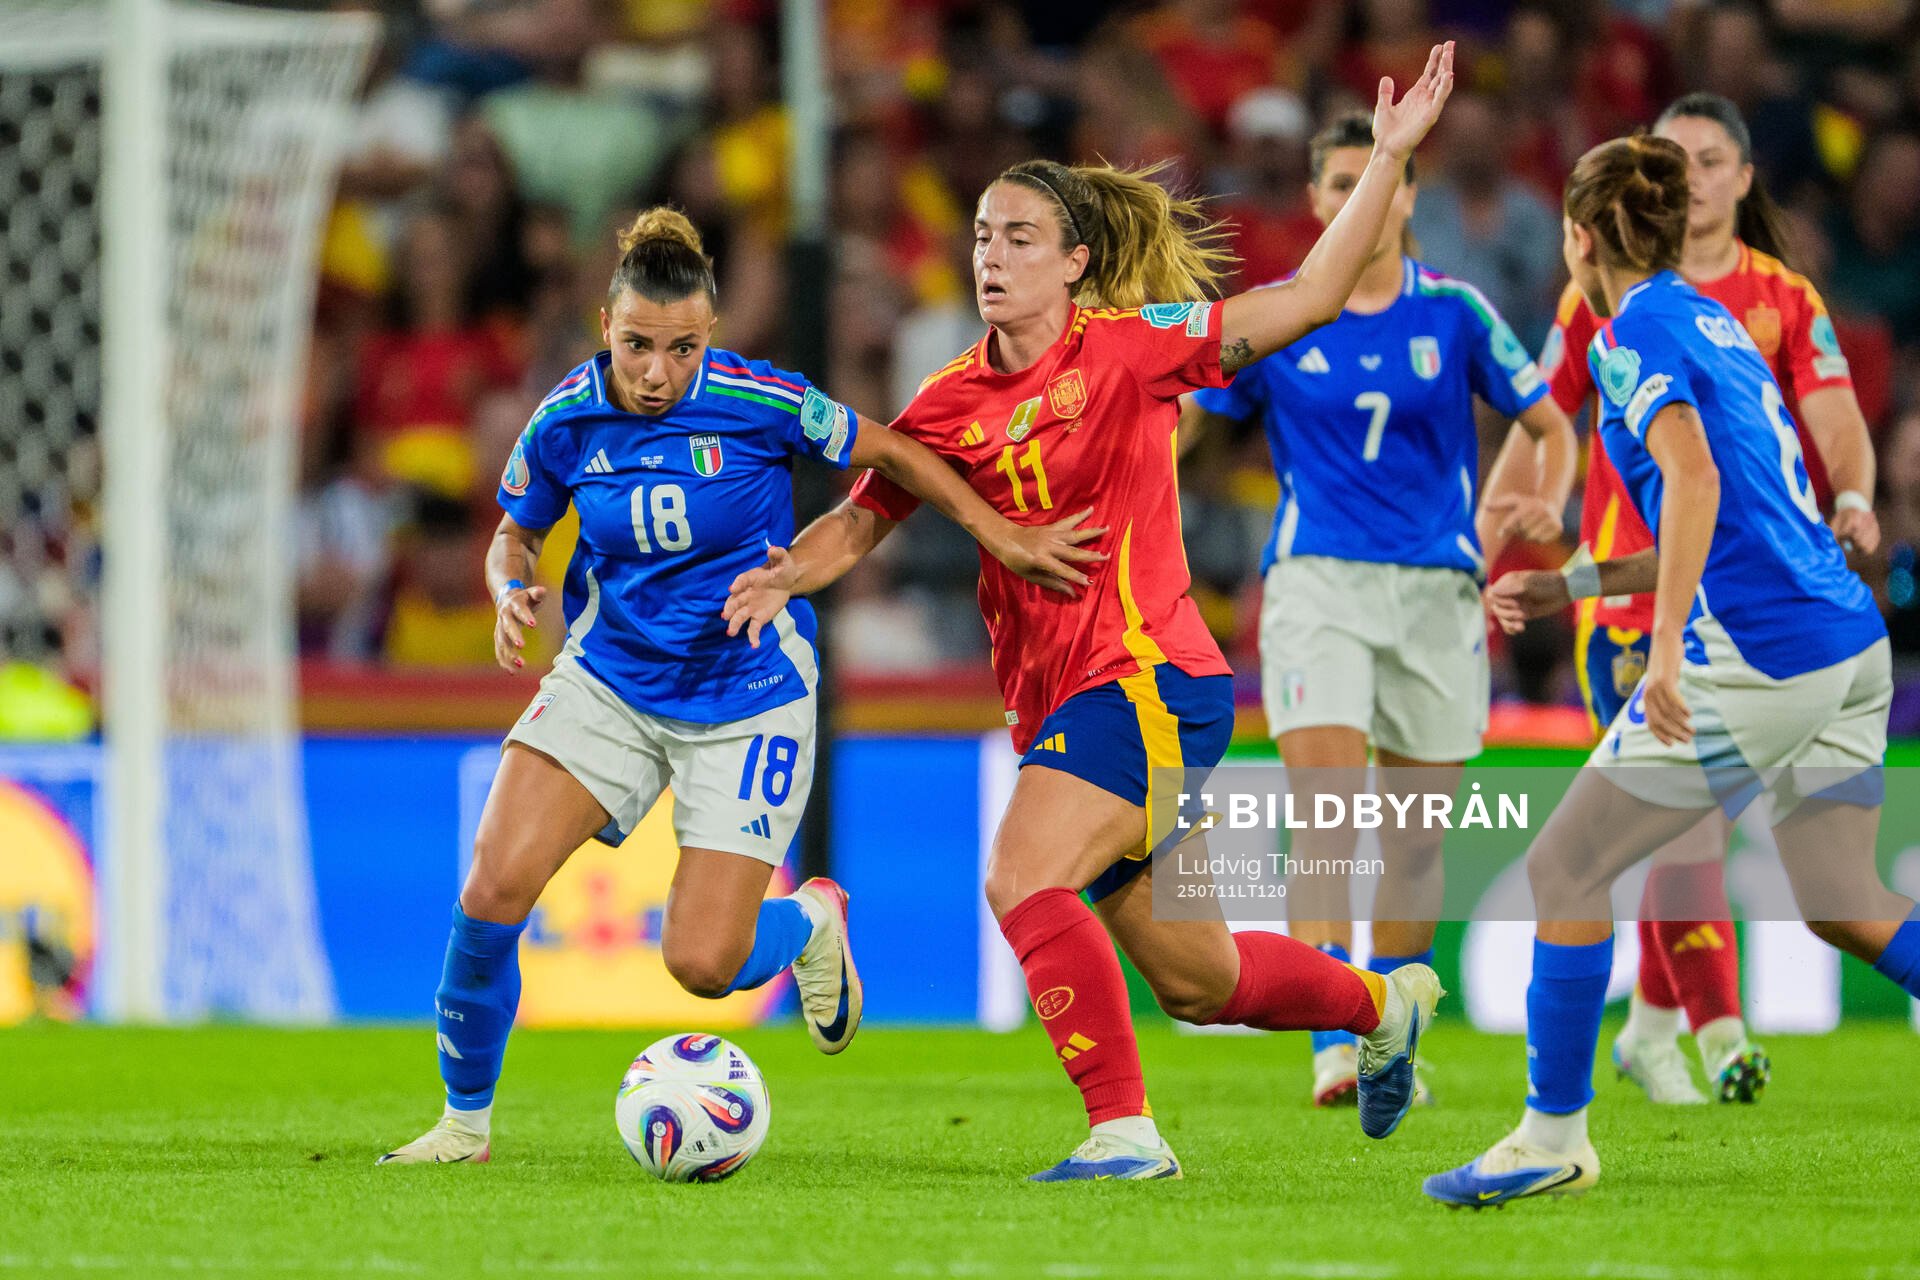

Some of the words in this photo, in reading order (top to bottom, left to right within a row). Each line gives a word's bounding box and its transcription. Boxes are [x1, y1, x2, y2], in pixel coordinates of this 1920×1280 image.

[692, 435, 718, 448] ITALIA
[1354, 391, 1392, 462] 7
[996, 439, 1054, 513] 11
[630, 483, 693, 554] 18
[738, 733, 799, 808] 18
